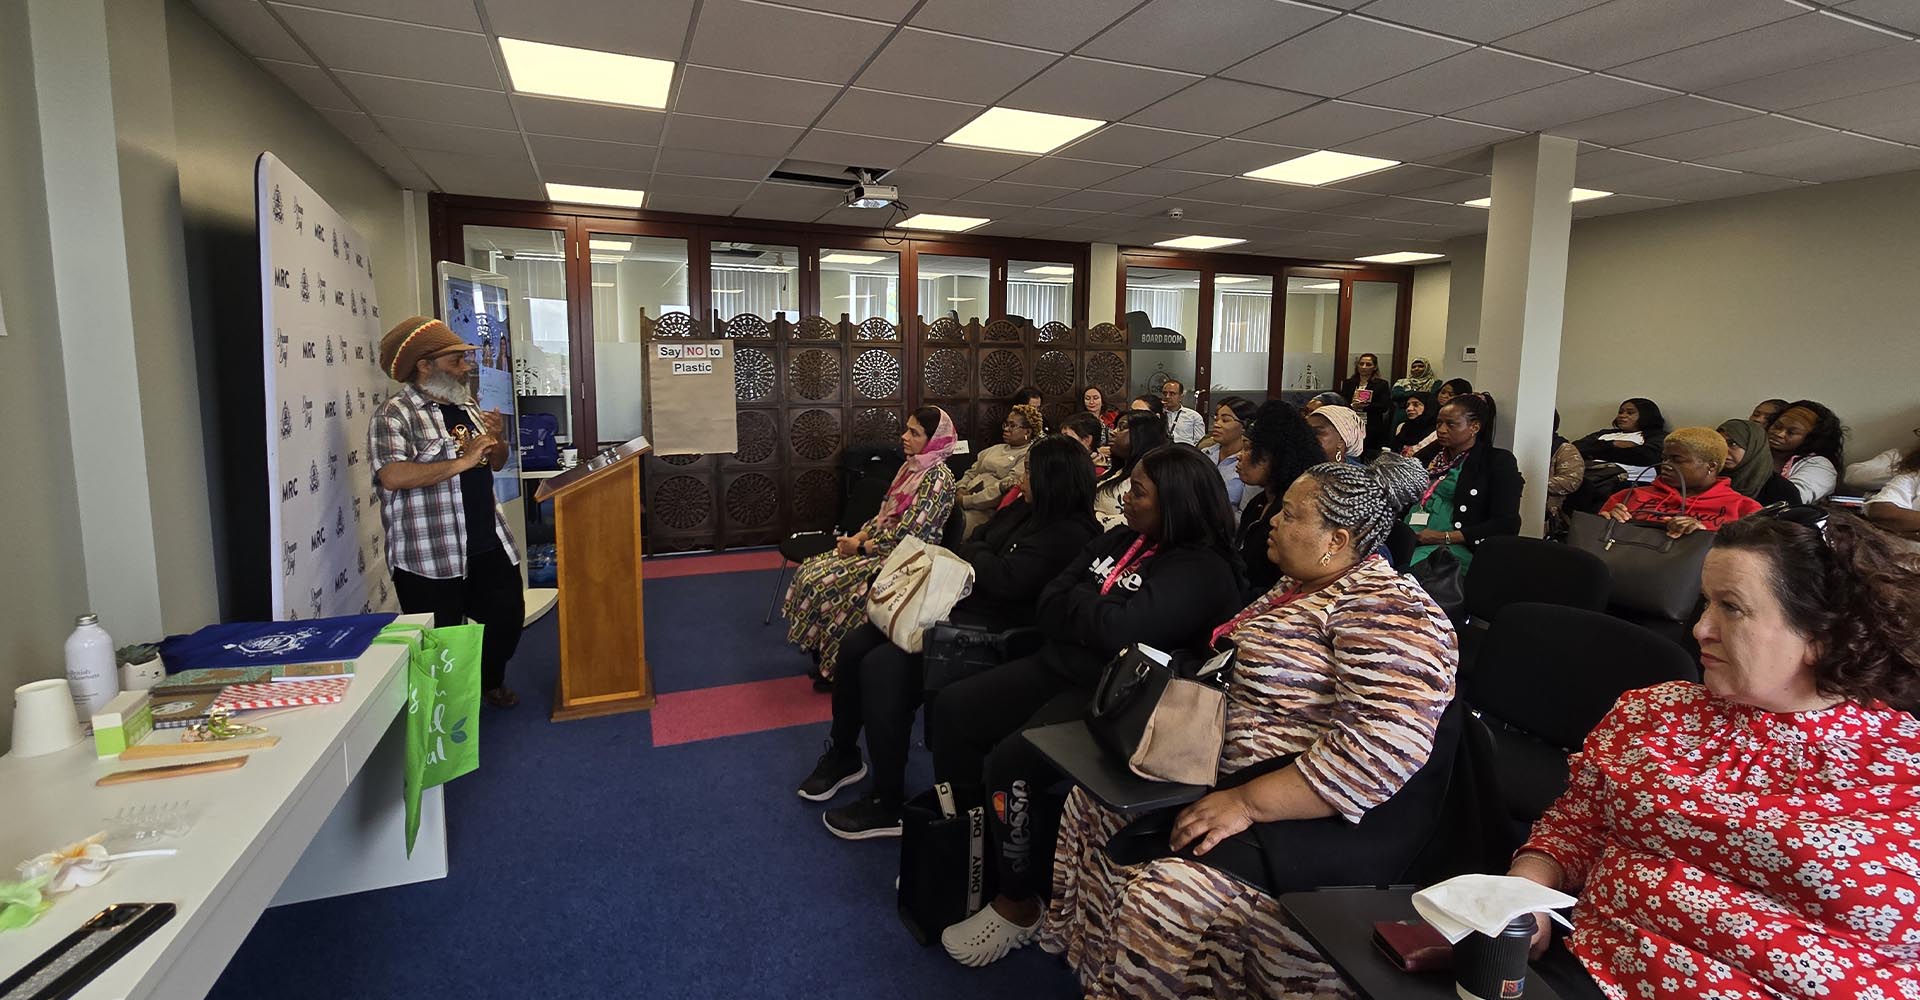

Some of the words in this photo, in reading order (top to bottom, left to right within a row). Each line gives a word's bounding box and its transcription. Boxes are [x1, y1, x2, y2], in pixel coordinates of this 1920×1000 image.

[274, 267, 290, 289] MRC
[1141, 334, 1163, 343] BOARD
[1163, 334, 1183, 344] ROOM
[302, 341, 316, 359] MRC
[660, 347, 681, 358] Say
[687, 347, 704, 356] NO
[710, 348, 720, 356] to
[674, 363, 711, 372] Plastic
[324, 401, 337, 419] MRC
[347, 449, 359, 467] MRC
[282, 478, 298, 503] MRC
[310, 527, 326, 552] MRC
[335, 568, 348, 592] MRC
[972, 856, 981, 893] DKNY
